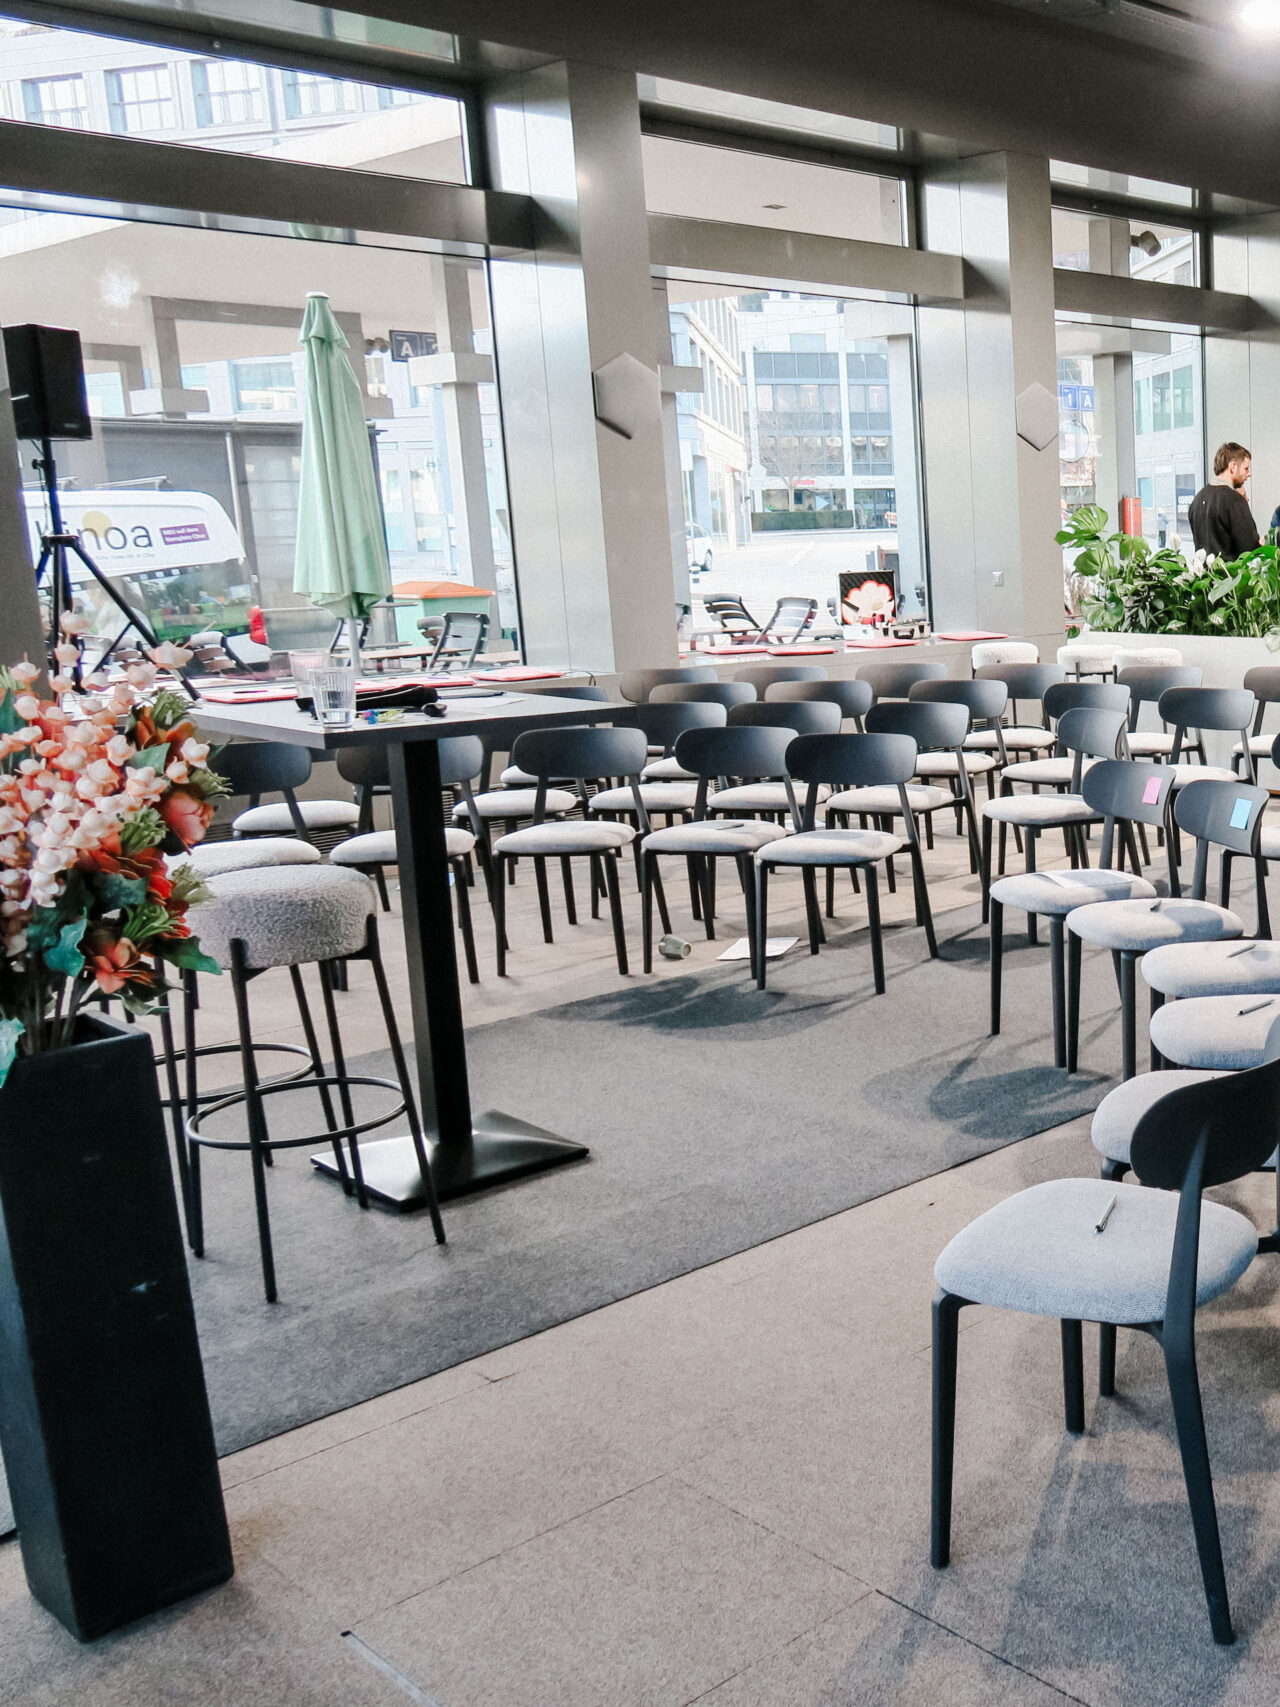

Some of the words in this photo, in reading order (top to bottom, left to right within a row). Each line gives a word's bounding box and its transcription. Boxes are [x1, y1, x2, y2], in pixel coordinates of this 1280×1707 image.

[400, 341, 414, 357] A
[1083, 394, 1092, 408] A
[35, 520, 153, 550] noa
